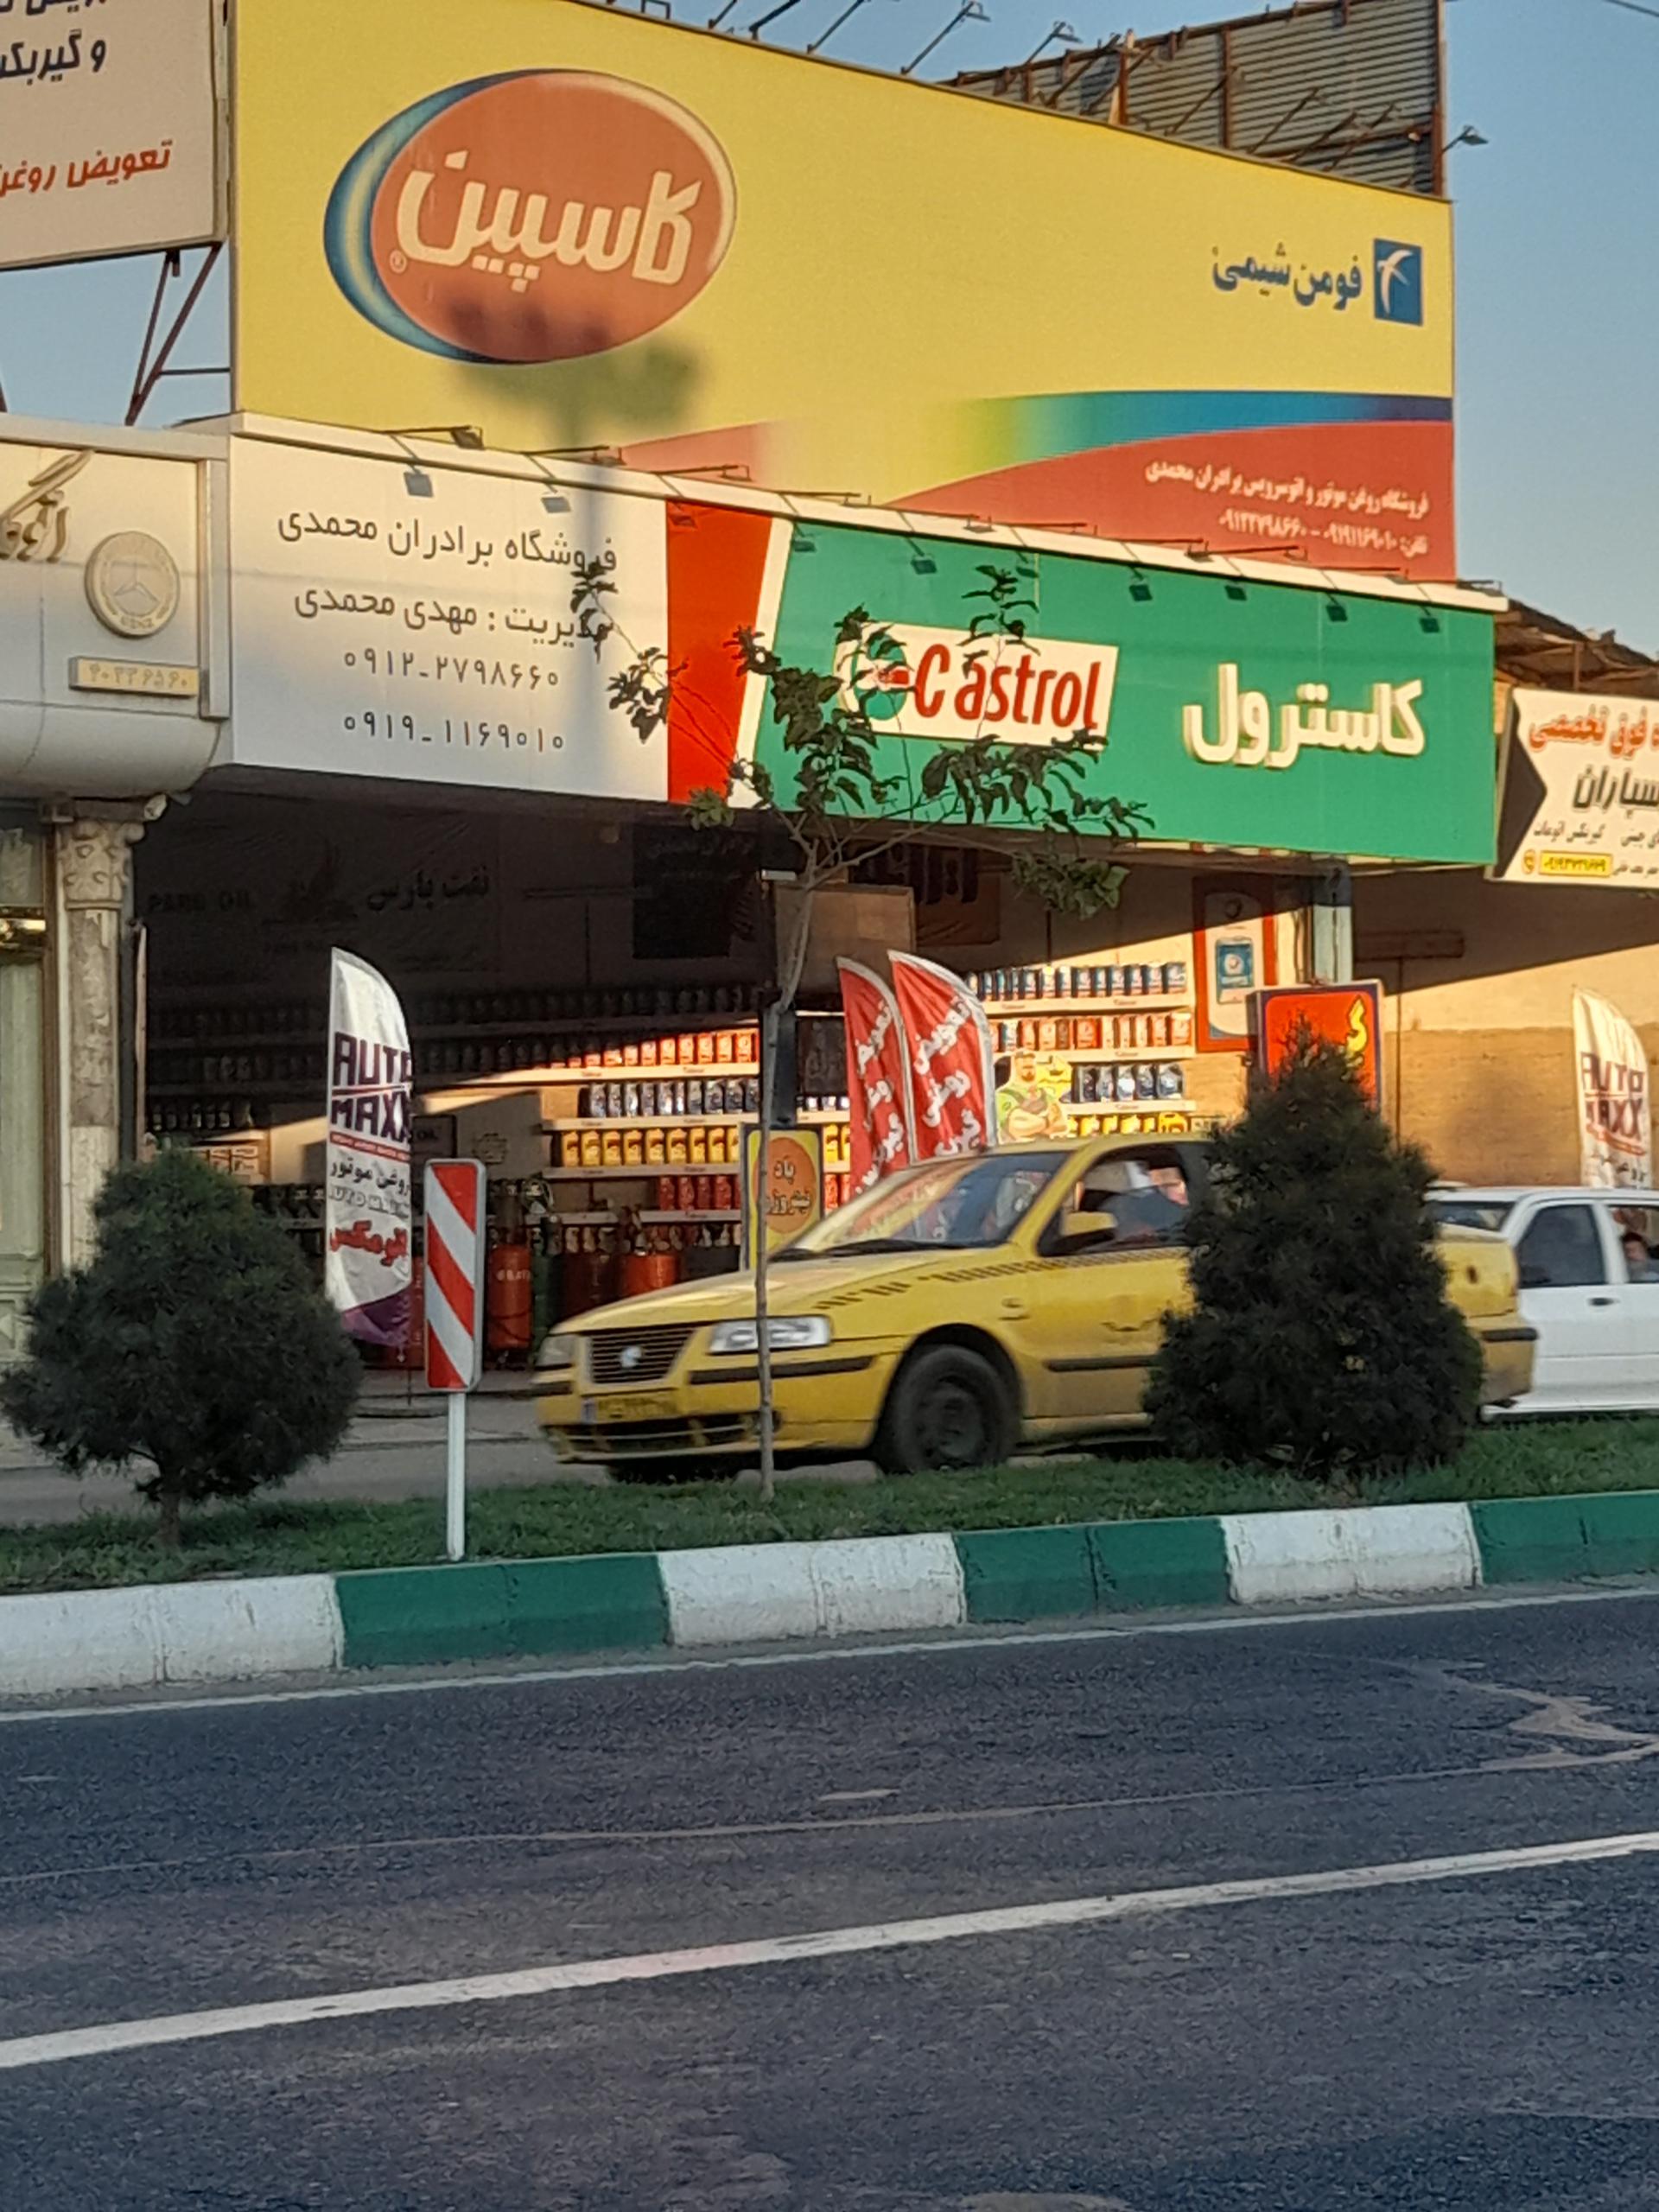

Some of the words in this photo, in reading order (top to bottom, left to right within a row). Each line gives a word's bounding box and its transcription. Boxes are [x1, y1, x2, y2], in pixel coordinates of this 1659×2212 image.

[91, 40, 106, 73] و
[67, 139, 173, 189] تعویض
[396, 149, 703, 294] کاسپین
[1211, 242, 1291, 296] شیمی
[1294, 255, 1363, 311] فومن
[278, 511, 378, 543] محمدی
[388, 517, 493, 567] برادران
[505, 529, 618, 576] فوشگاه
[295, 588, 395, 619] محمدی
[404, 599, 477, 635] مهدی
[913, 643, 1102, 730] Castrol
[1182, 662, 1426, 770] کاسترول
